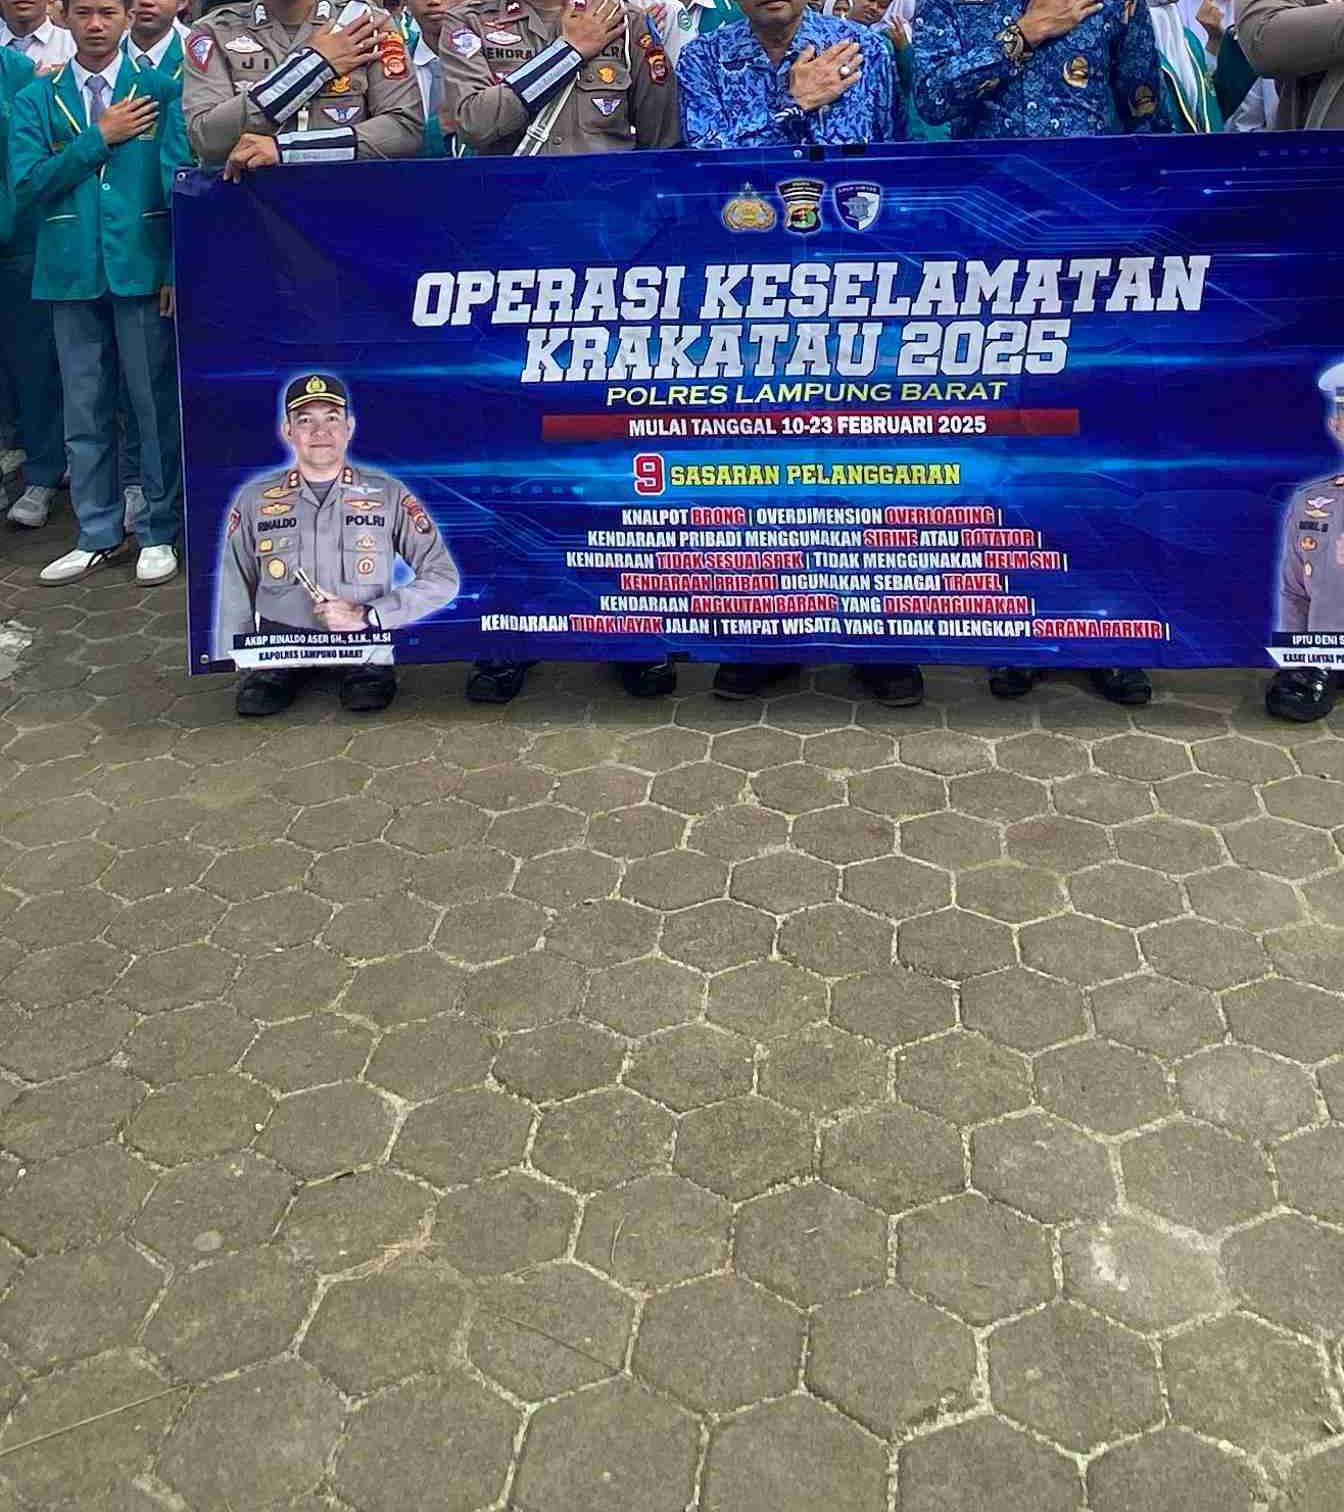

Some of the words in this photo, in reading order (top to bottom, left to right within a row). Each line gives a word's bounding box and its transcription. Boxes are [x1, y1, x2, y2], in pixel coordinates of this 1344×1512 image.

[411, 265, 685, 327] OPERASI
[699, 255, 1211, 320] KESELAMATAN
[520, 321, 883, 383] KRAKATAU
[896, 319, 1071, 377] 2025
[607, 384, 728, 406] POLRES
[735, 383, 891, 405] LAMPUNG
[900, 381, 1008, 401] BARAT
[629, 419, 687, 436] MULAI
[691, 418, 777, 436] TANGGAL
[782, 417, 833, 434] 10-23
[837, 416, 933, 434] FEBRUARI
[938, 415, 987, 433] 2025
[633, 452, 665, 496] 9
[670, 464, 780, 486] SASARAN
[786, 464, 960, 485] PELANGGARAN
[345, 515, 385, 527] POLRI
[622, 509, 688, 525] KNALPOT
[689, 507, 745, 525] BRONG
[756, 508, 882, 525] OVERDIMENSION
[884, 506, 995, 524] OVERLOADING
[587, 531, 676, 547] KENDARAAN
[679, 531, 742, 547] PRIBADI
[745, 530, 862, 547] MENGGUNAKAN
[863, 529, 918, 547] SIRINE
[920, 531, 958, 546] ATAU
[960, 529, 1035, 546] ROTATOR
[566, 551, 654, 568] KENDARAAN
[656, 551, 705, 569] TIDAK
[705, 551, 761, 569] SESUAI
[814, 551, 860, 568] TIDAK
[863, 552, 983, 568] MENGGUNAKAN
[984, 551, 1029, 569] HELM
[1030, 551, 1061, 569] SNI
[621, 573, 713, 591] KENDARAAN
[713, 574, 779, 592] PRIBADI
[781, 574, 870, 590] DIGUNAKAN
[873, 574, 940, 591] SEBAGAI
[942, 573, 1003, 591] TRAVEL
[600, 596, 689, 612] KENDARAAN
[690, 595, 773, 614] ANGKUTAN
[774, 594, 840, 614] BARANG
[841, 596, 881, 612] YANG
[882, 595, 1029, 614] DISALAHGUNAKAN
[480, 614, 568, 633] KENDARAAN
[569, 615, 617, 633] TIDAK
[665, 618, 709, 634] JALAN
[721, 619, 779, 635] TEMPAT
[781, 617, 842, 635] WISATA
[843, 619, 884, 635] YANG
[886, 619, 936, 636] TIDAK
[937, 619, 1032, 637] DILENGKAPI
[1032, 619, 1101, 638] SARANA
[1101, 620, 1163, 638] PARKIR
[1292, 635, 1313, 645] IPTU
[1314, 635, 1338, 645] DENI
[258, 650, 298, 661] KAPOLRES
[300, 649, 336, 659] LAMPUNG
